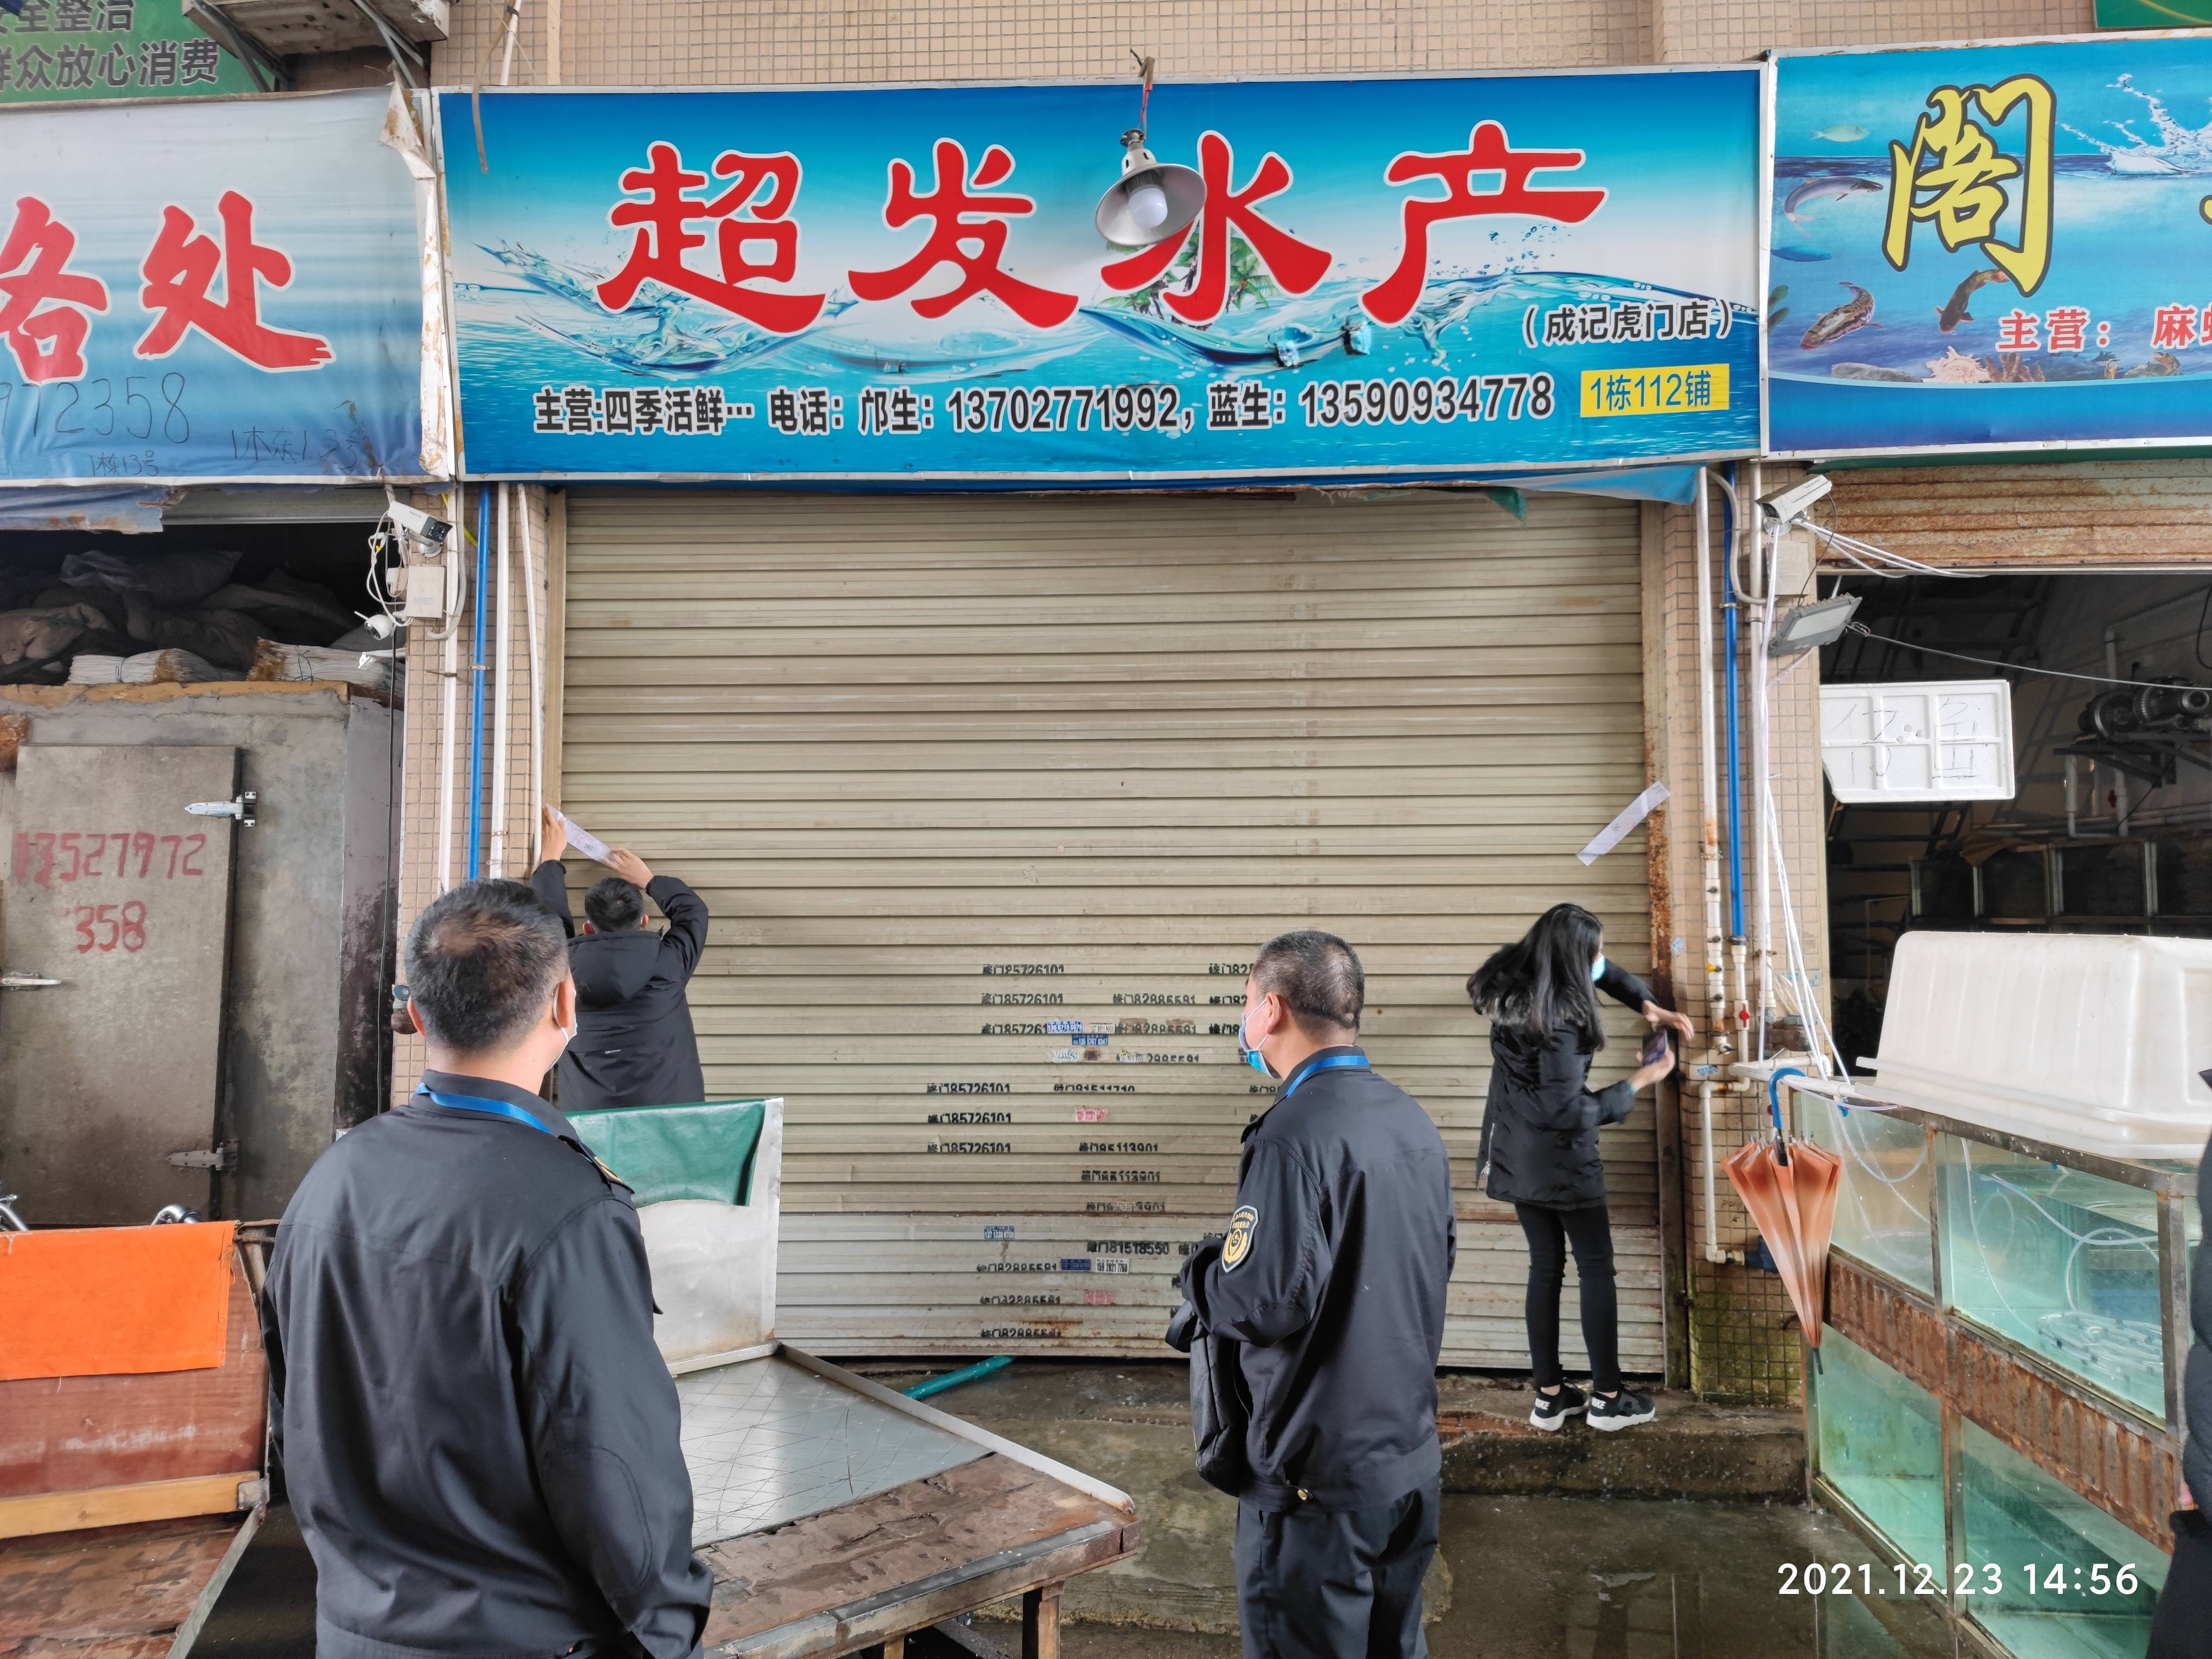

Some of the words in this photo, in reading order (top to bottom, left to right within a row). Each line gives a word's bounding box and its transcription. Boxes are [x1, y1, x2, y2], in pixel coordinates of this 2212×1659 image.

[0, 0, 133, 34] 全整治
[597, 120, 1607, 333] 超发水产
[2153, 305, 2212, 347] 麻
[1301, 375, 1551, 424] 13590934778
[1591, 370, 1712, 411] 1栋112铺
[74, 901, 147, 954] 358
